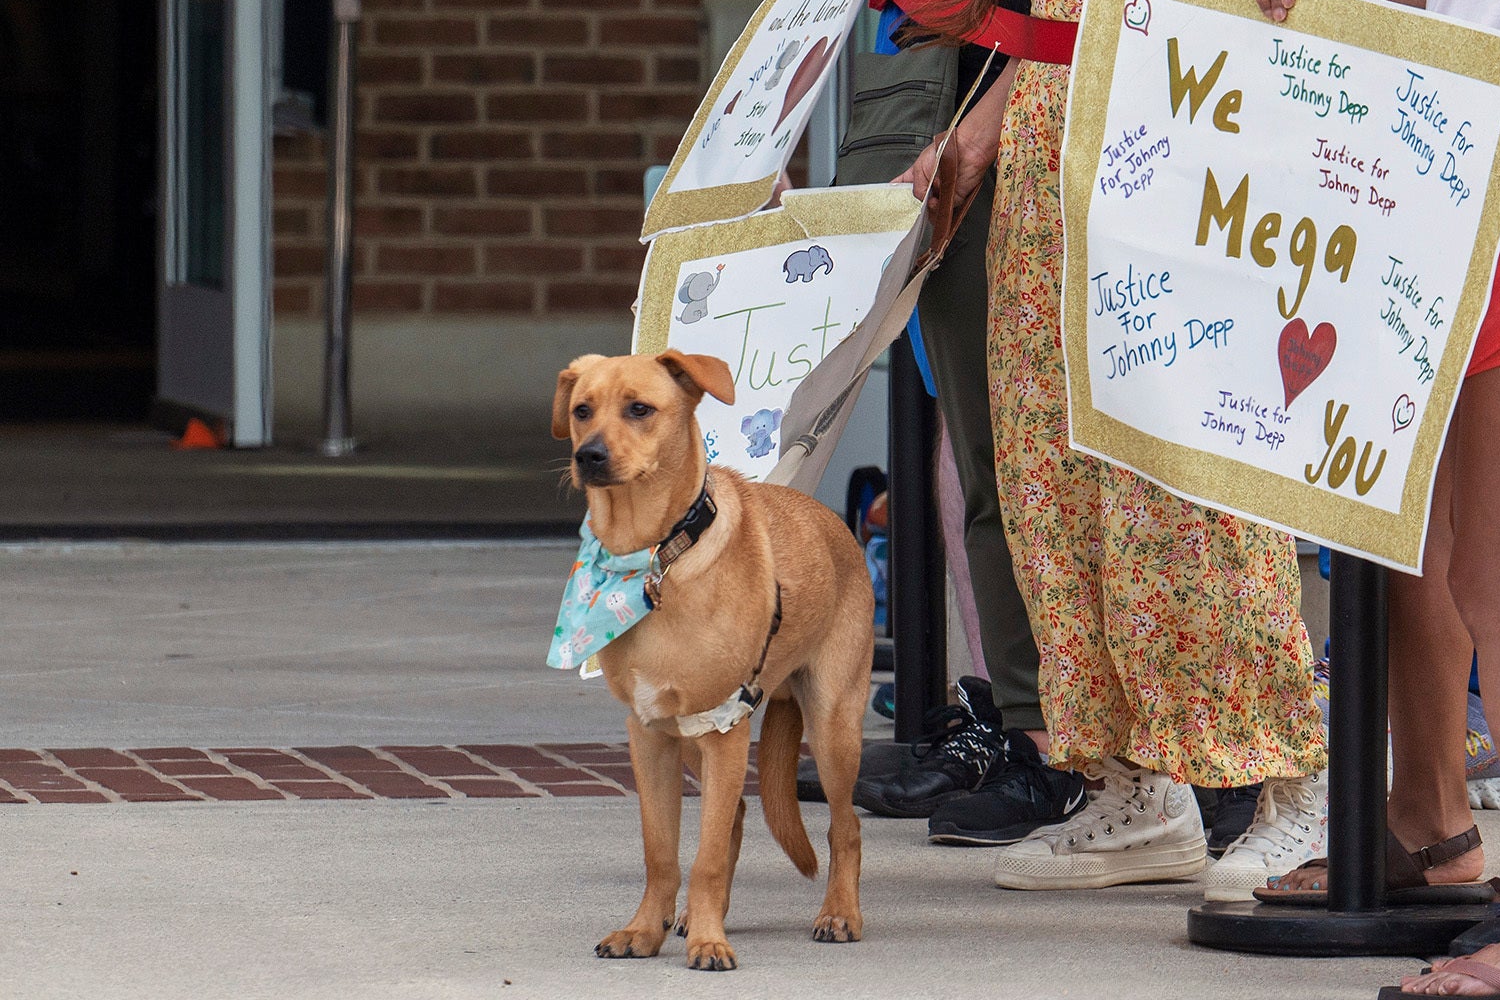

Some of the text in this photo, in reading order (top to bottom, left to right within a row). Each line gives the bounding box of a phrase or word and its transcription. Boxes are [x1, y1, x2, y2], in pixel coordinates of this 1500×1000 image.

[1268, 38, 1351, 79] Justice for
[1166, 37, 1244, 134] We
[1279, 73, 1369, 124] Johnny Depp
[1396, 68, 1474, 156] Justice for
[1100, 135, 1171, 195] for Johnny
[1103, 124, 1147, 167] Justice
[1312, 138, 1389, 180] Justice for
[1391, 108, 1470, 207] Johnny Depp
[1119, 167, 1154, 198] Depp
[1319, 168, 1396, 217] Johnny Depp
[1195, 166, 1358, 320] Mega
[1091, 263, 1173, 316] Justice
[1381, 255, 1444, 330] Justice for
[1102, 318, 1234, 380] Johnny Depp
[1380, 297, 1435, 385] Johnny Depp
[1201, 411, 1285, 450] Johnny Depp
[1218, 390, 1291, 424] Justice for
